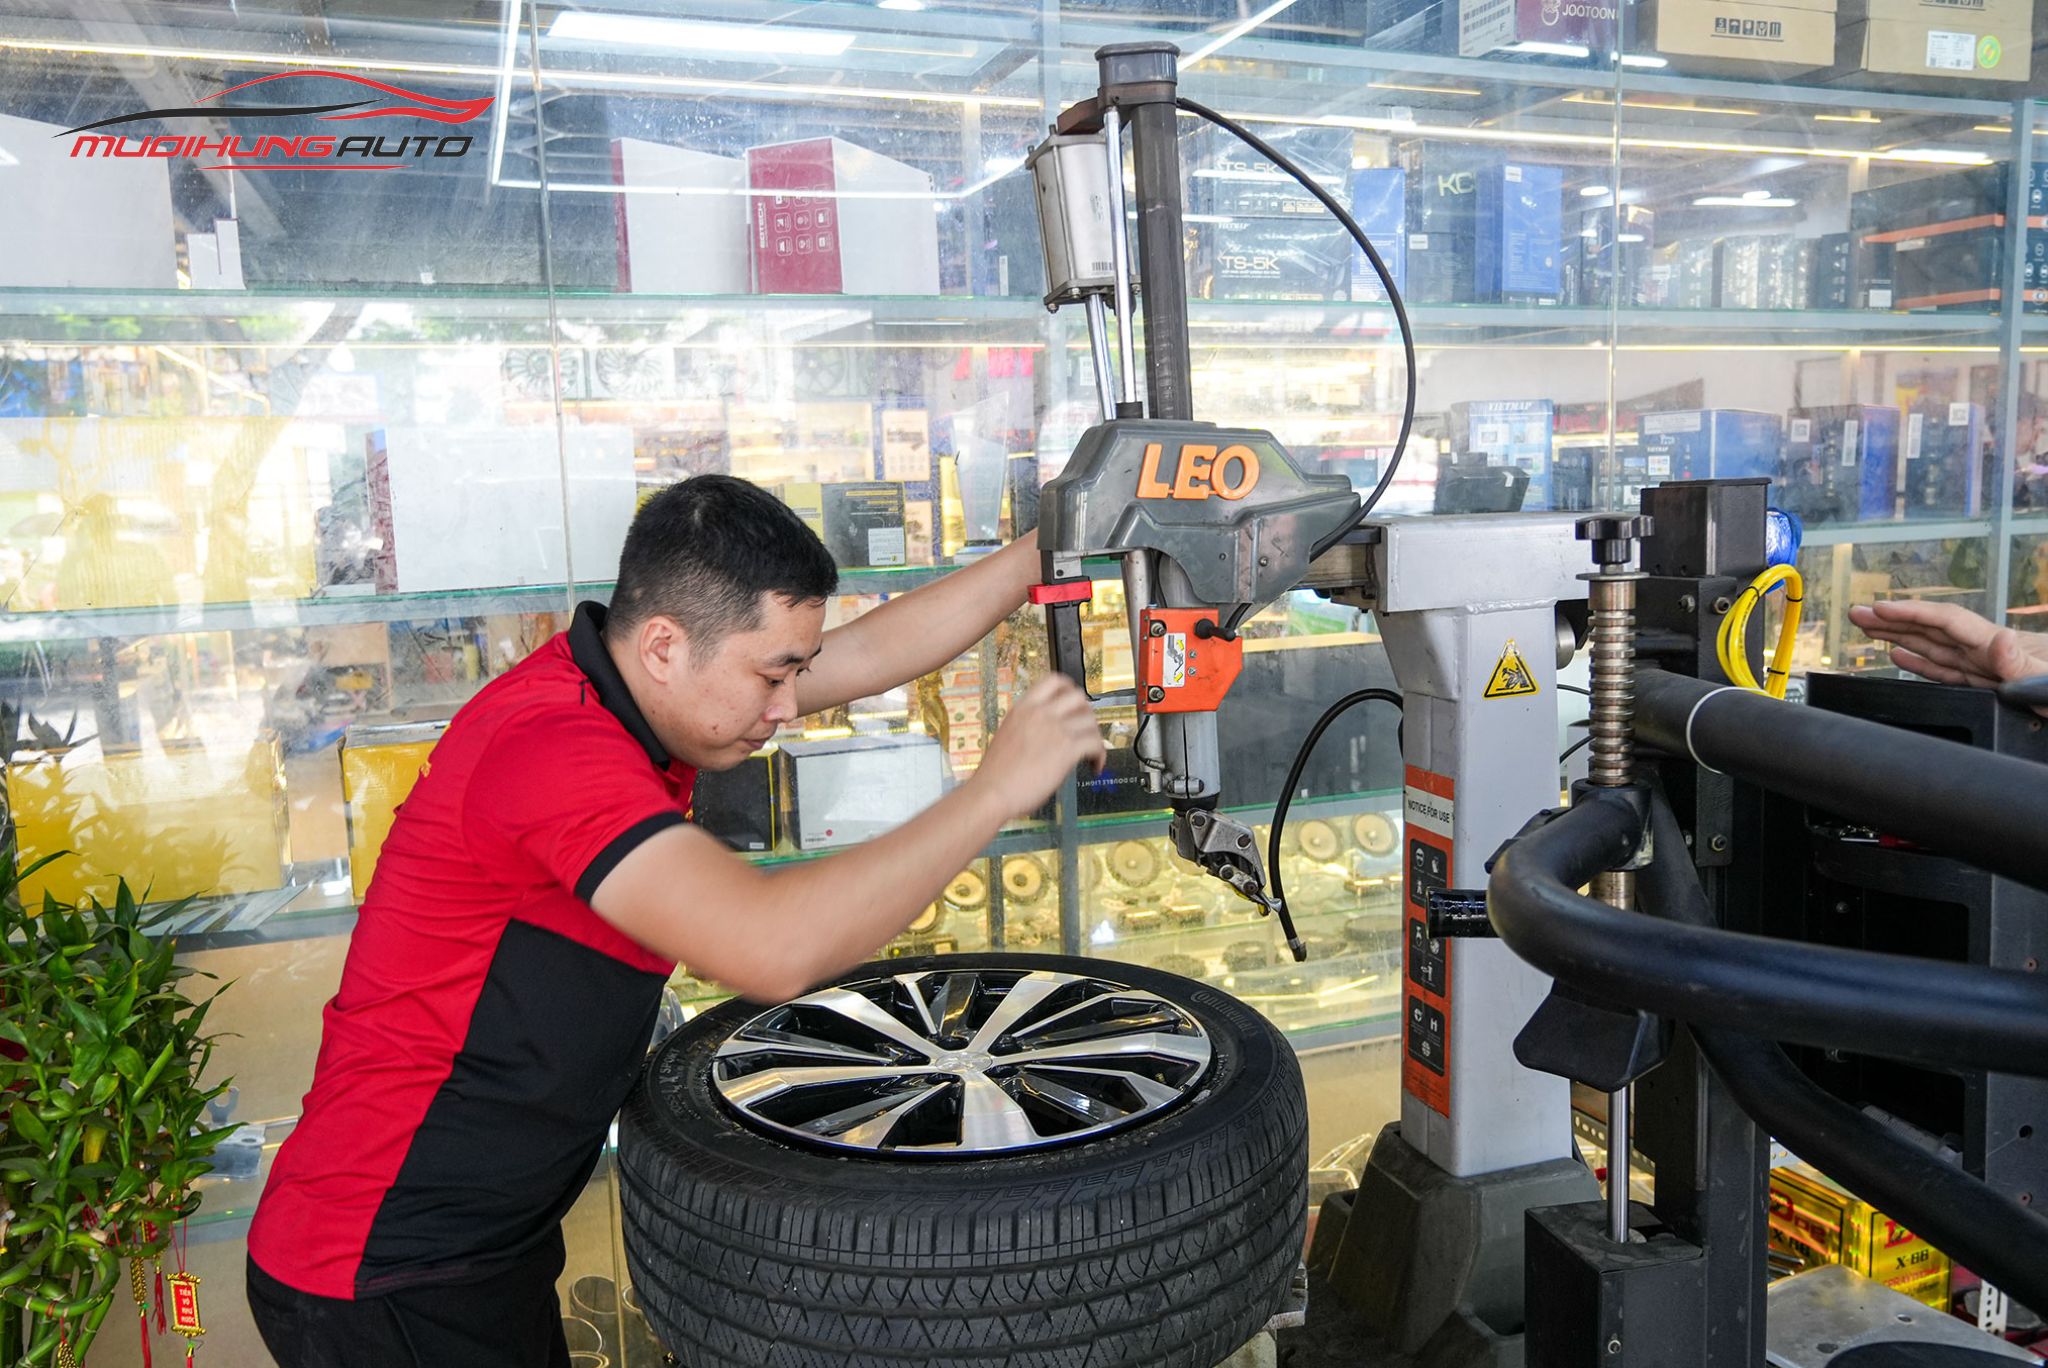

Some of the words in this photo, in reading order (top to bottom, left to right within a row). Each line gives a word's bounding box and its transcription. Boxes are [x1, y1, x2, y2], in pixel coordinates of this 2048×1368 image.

[1562, 3, 1616, 20] JOOTOON
[1221, 255, 1280, 271] TS-5K
[1136, 442, 1260, 500] LEO
[1407, 799, 1427, 815] NOTICE
[1427, 806, 1439, 819] FOR
[1439, 810, 1450, 824] USE
